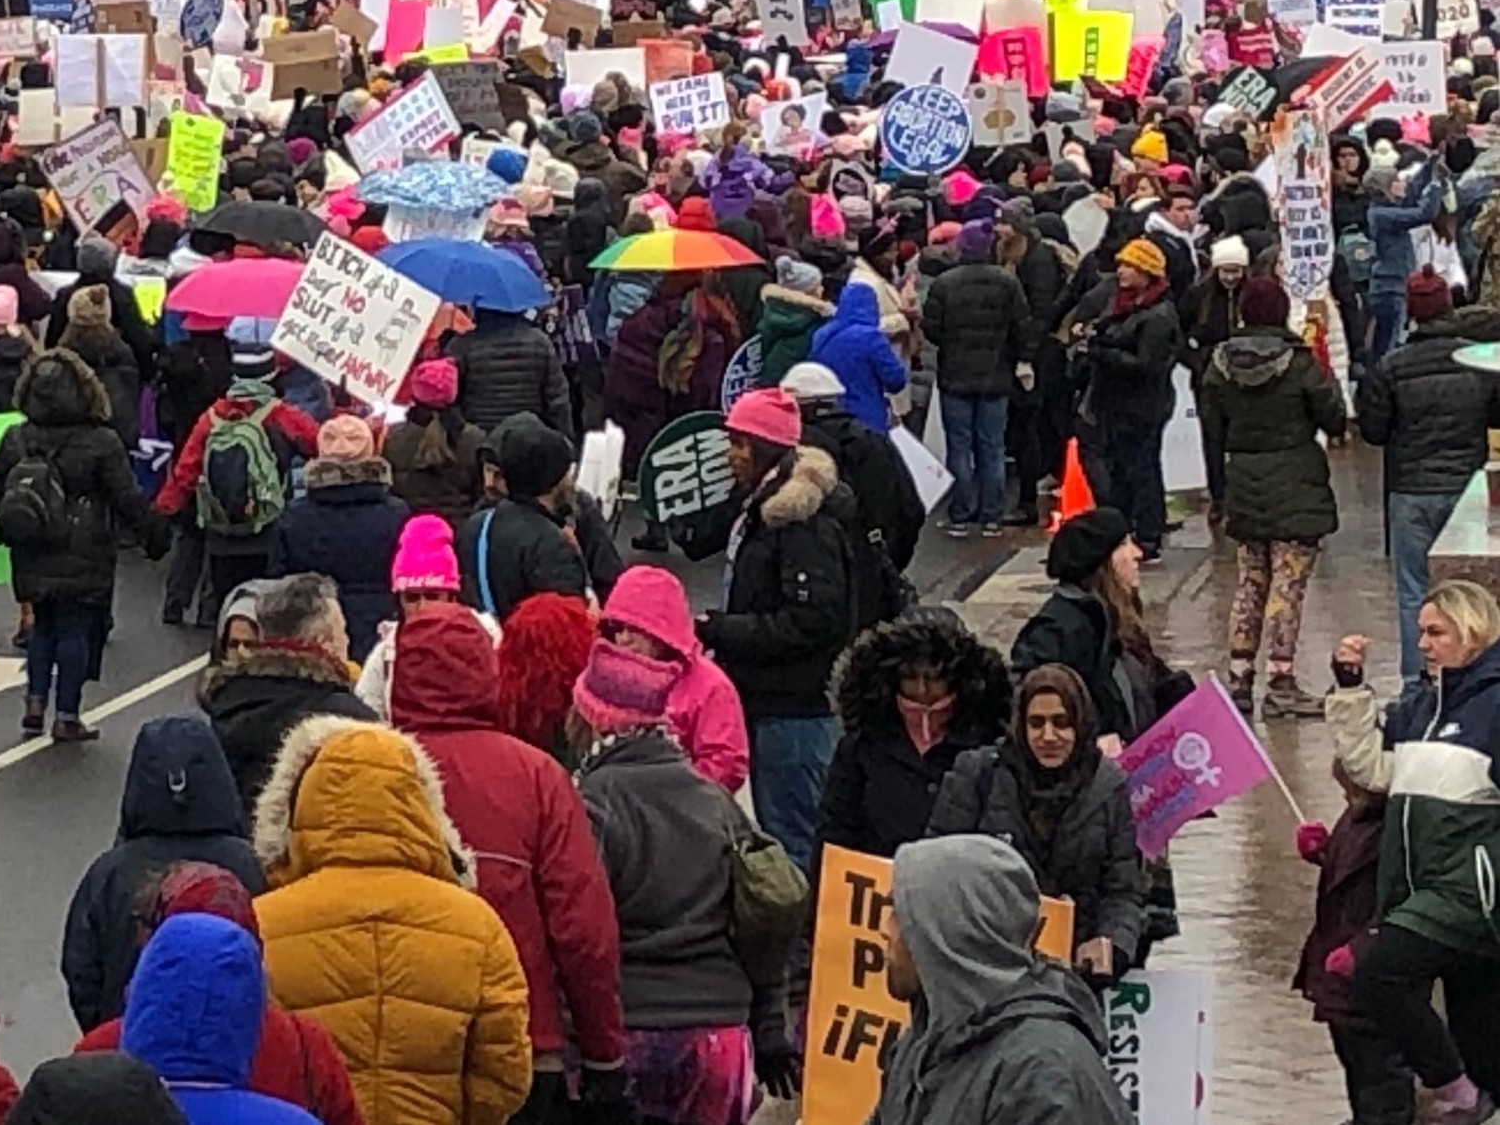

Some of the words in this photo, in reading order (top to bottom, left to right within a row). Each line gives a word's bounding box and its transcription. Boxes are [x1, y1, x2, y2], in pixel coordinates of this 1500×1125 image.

[1437, 3, 1470, 23] 020
[909, 88, 962, 116] KEEP
[1232, 67, 1278, 114] ERA
[888, 100, 967, 149] ABORTION
[889, 125, 951, 167] LEGAL
[316, 236, 369, 282] BITCH
[291, 285, 336, 324] SLUT
[340, 285, 367, 315] NO
[651, 433, 702, 523] ERA
[695, 428, 737, 508] NOW
